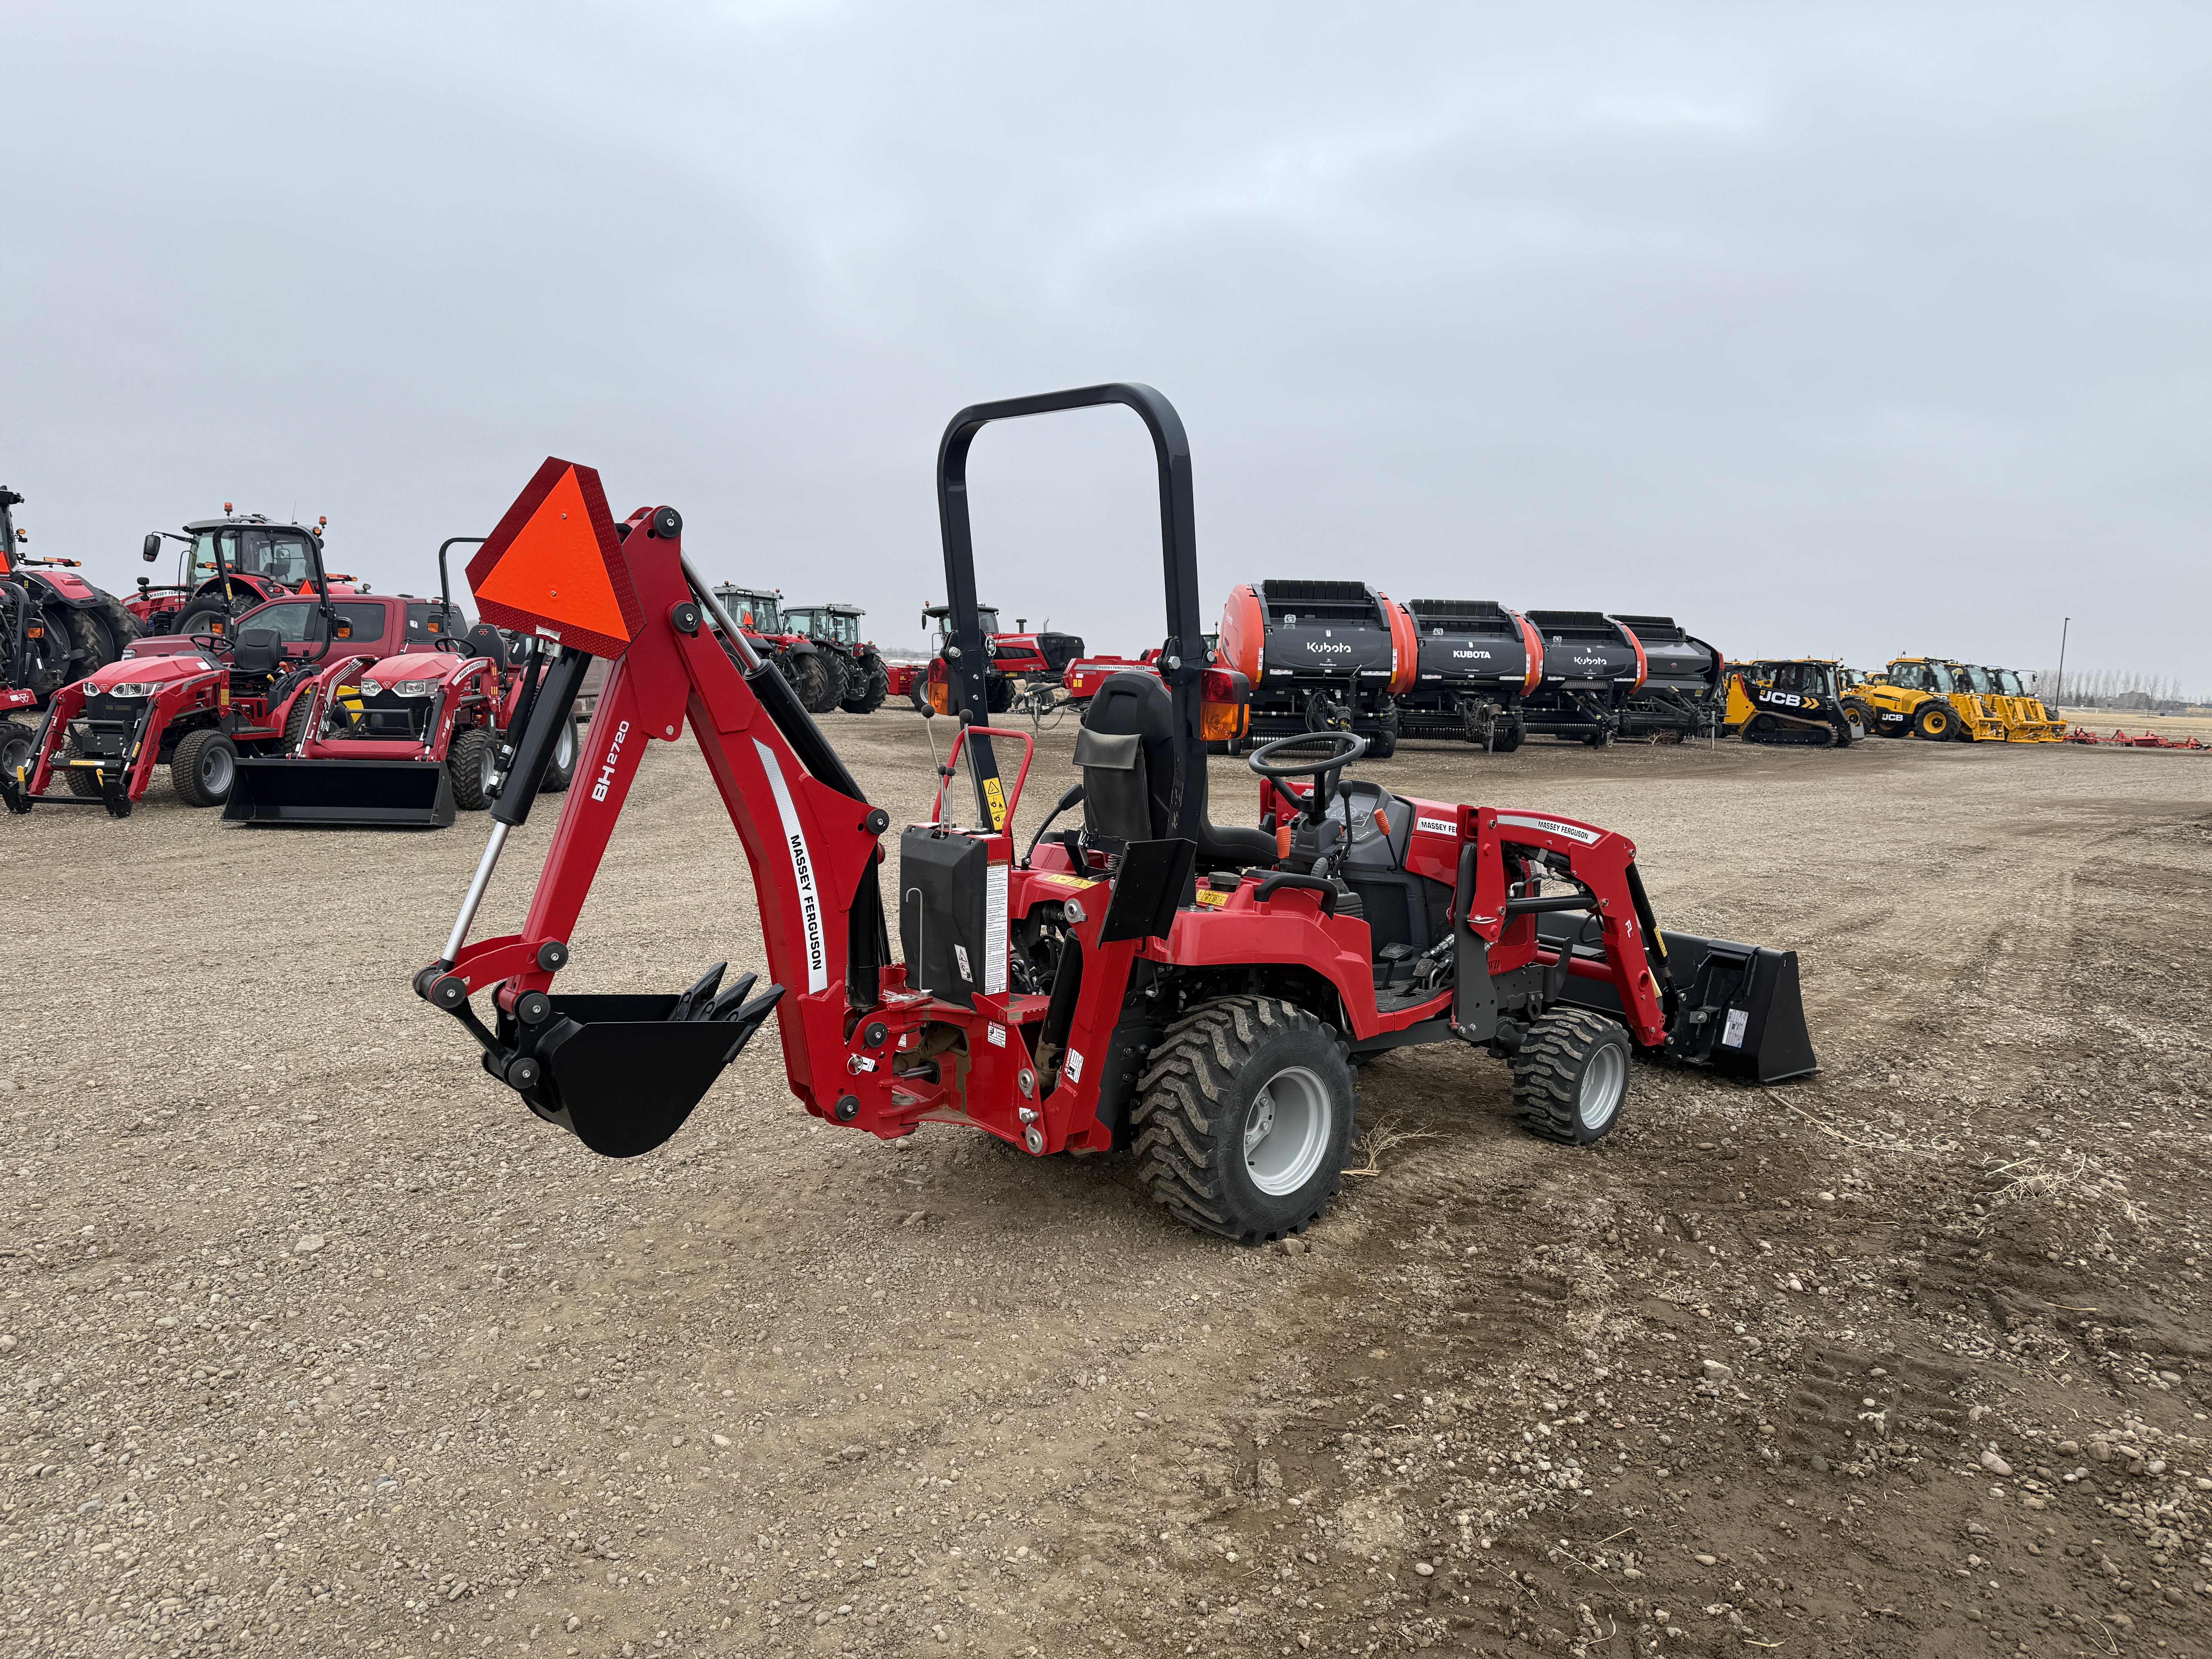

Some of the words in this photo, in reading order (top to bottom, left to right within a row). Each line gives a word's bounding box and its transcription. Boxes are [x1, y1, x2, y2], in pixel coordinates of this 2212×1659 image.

[1307, 642, 1352, 653] Kubota
[1453, 650, 1491, 659] KUBOTA
[1574, 656, 1607, 665] Kubota
[1759, 690, 1801, 707] JCB
[1882, 713, 1903, 721] JCB
[591, 765, 615, 802] BH
[606, 720, 630, 765] 2720
[1421, 821, 1446, 831] MASSEY
[1538, 821, 1560, 831] MASSEY
[1561, 826, 1589, 840] FERGUSON
[790, 834, 812, 891] MASSEY
[804, 895, 822, 970] FERGUSON
